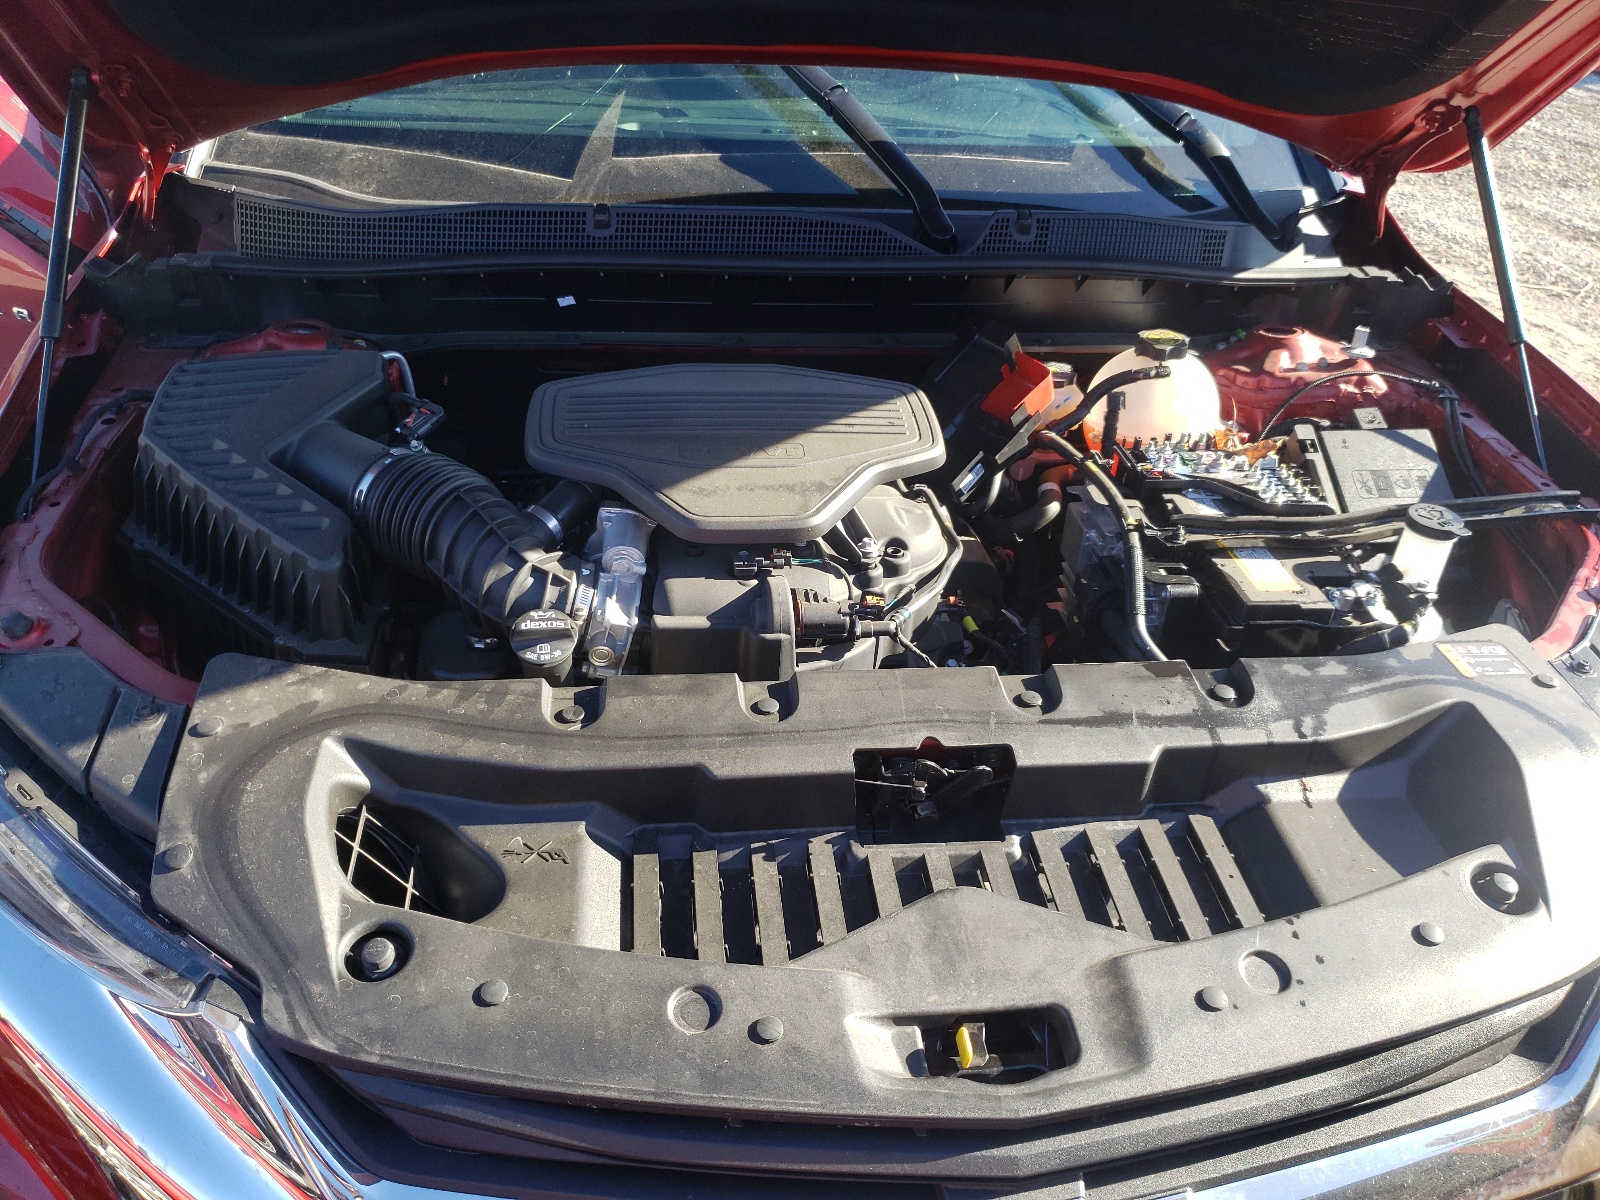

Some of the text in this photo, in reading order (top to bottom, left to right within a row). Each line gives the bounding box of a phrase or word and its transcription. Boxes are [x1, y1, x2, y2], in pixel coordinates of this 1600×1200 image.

[521, 619, 565, 630] dexos
[525, 649, 562, 661] SAE 5W-30
